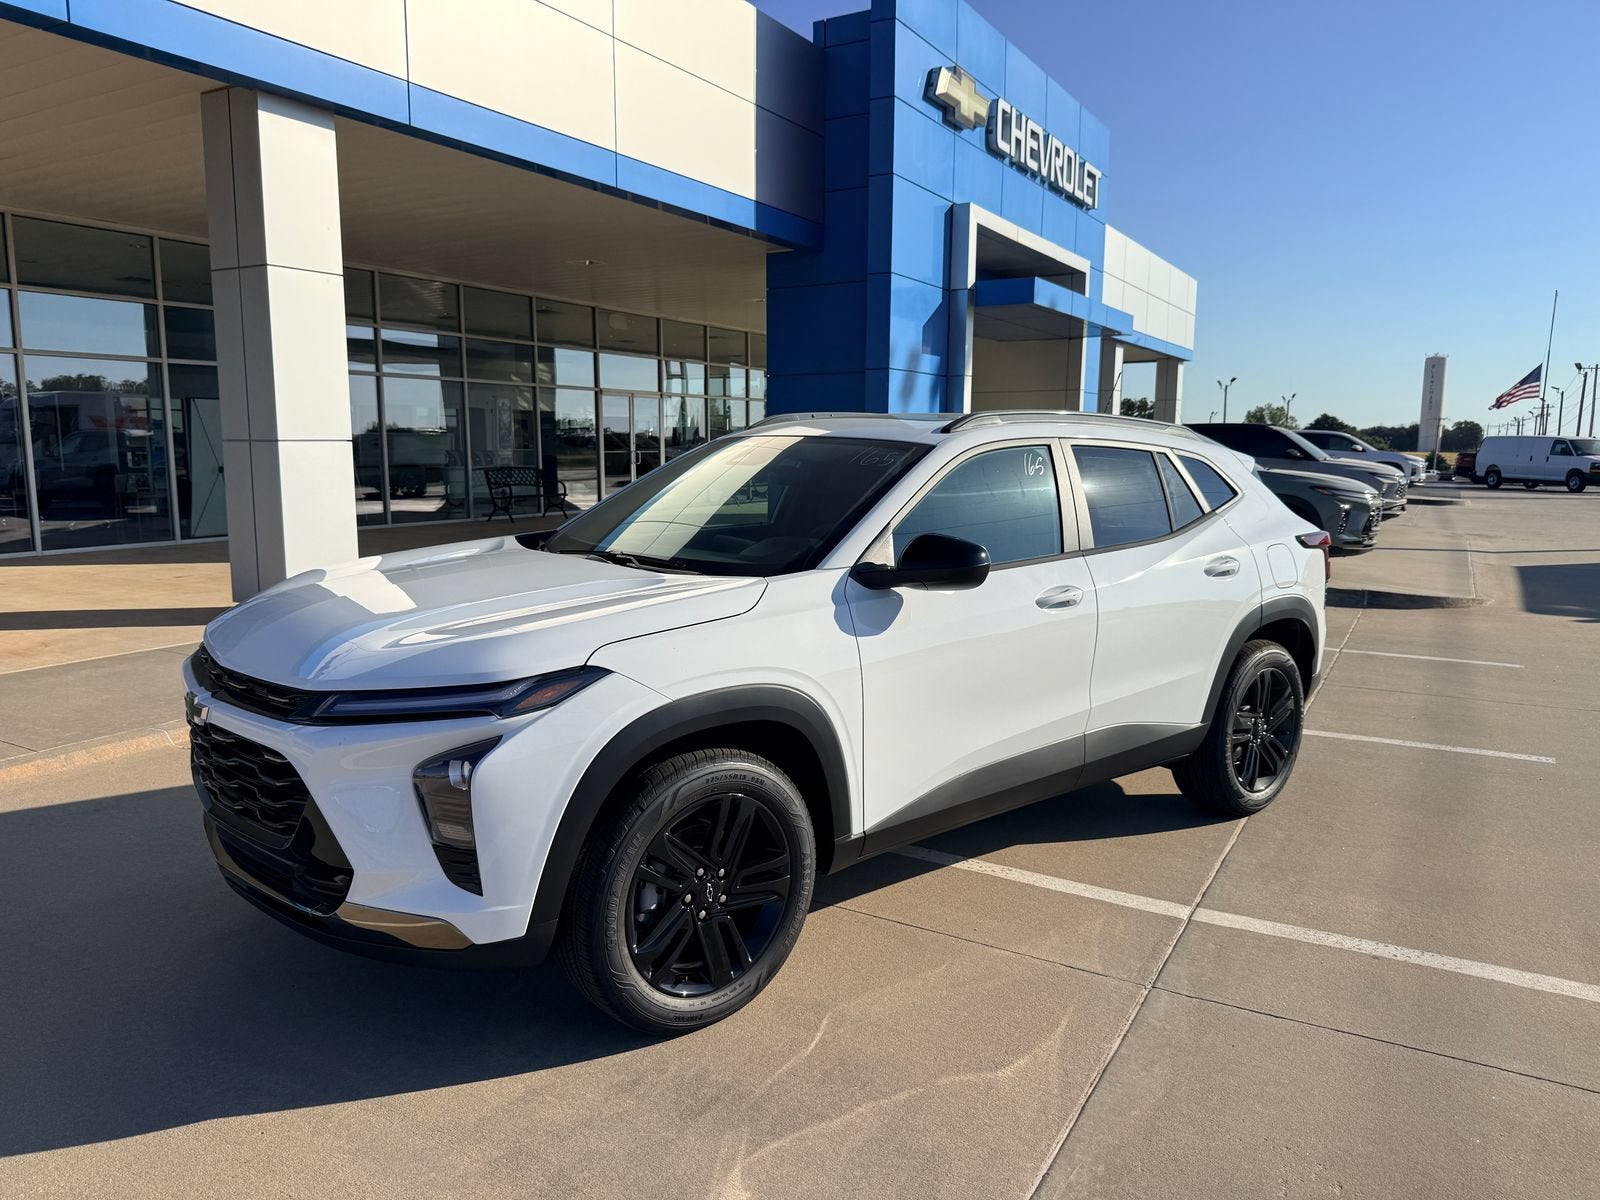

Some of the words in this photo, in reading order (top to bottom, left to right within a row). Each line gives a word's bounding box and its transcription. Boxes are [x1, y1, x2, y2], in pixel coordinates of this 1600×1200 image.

[996, 97, 1102, 209] CHEVROLET
[849, 448, 898, 466] 165
[1023, 452, 1045, 476] 165
